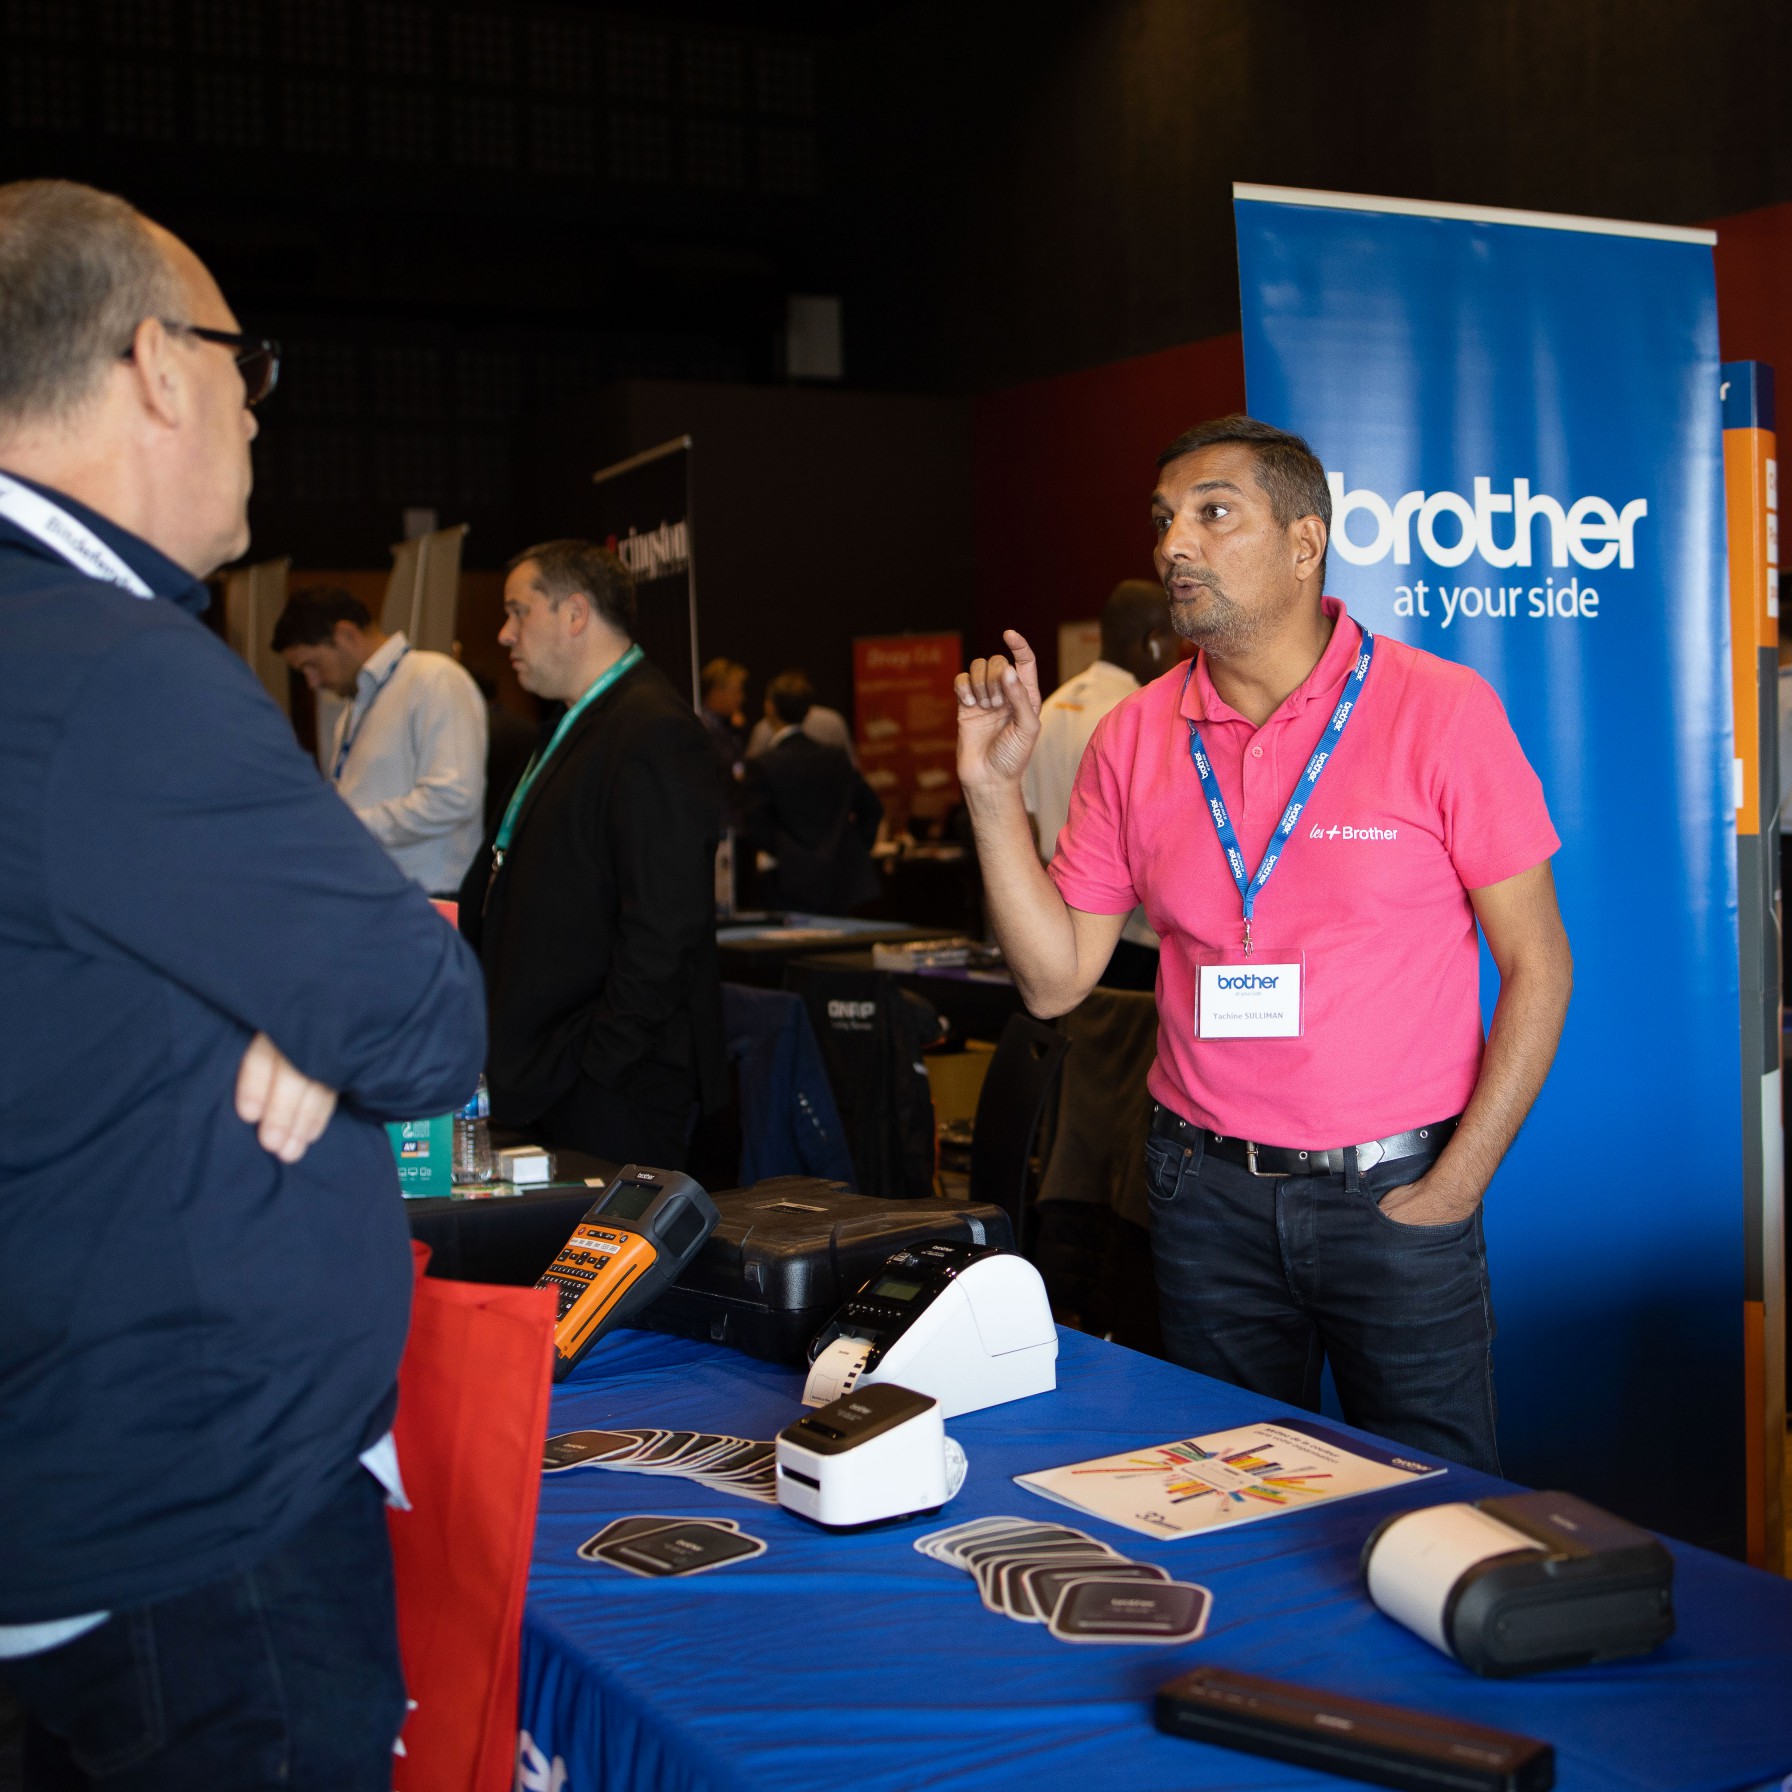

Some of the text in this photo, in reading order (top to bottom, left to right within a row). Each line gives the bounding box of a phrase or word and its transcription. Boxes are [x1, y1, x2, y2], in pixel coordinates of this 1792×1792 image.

[1327, 471, 1647, 569] brother
[1393, 578, 1600, 628] at your side
[1357, 654, 1371, 681] brother
[1335, 701, 1353, 731] brother
[1194, 752, 1209, 780] brother
[1309, 752, 1329, 782] brother
[1210, 799, 1225, 828] brother
[1284, 804, 1303, 834] brother
[1309, 823, 1325, 839] les
[1342, 826, 1398, 840] Brother
[1228, 849, 1243, 878] brother
[1259, 855, 1278, 885] brother
[1218, 974, 1279, 989] brother
[1213, 1012, 1283, 1020] Yachine SULLIMAN
